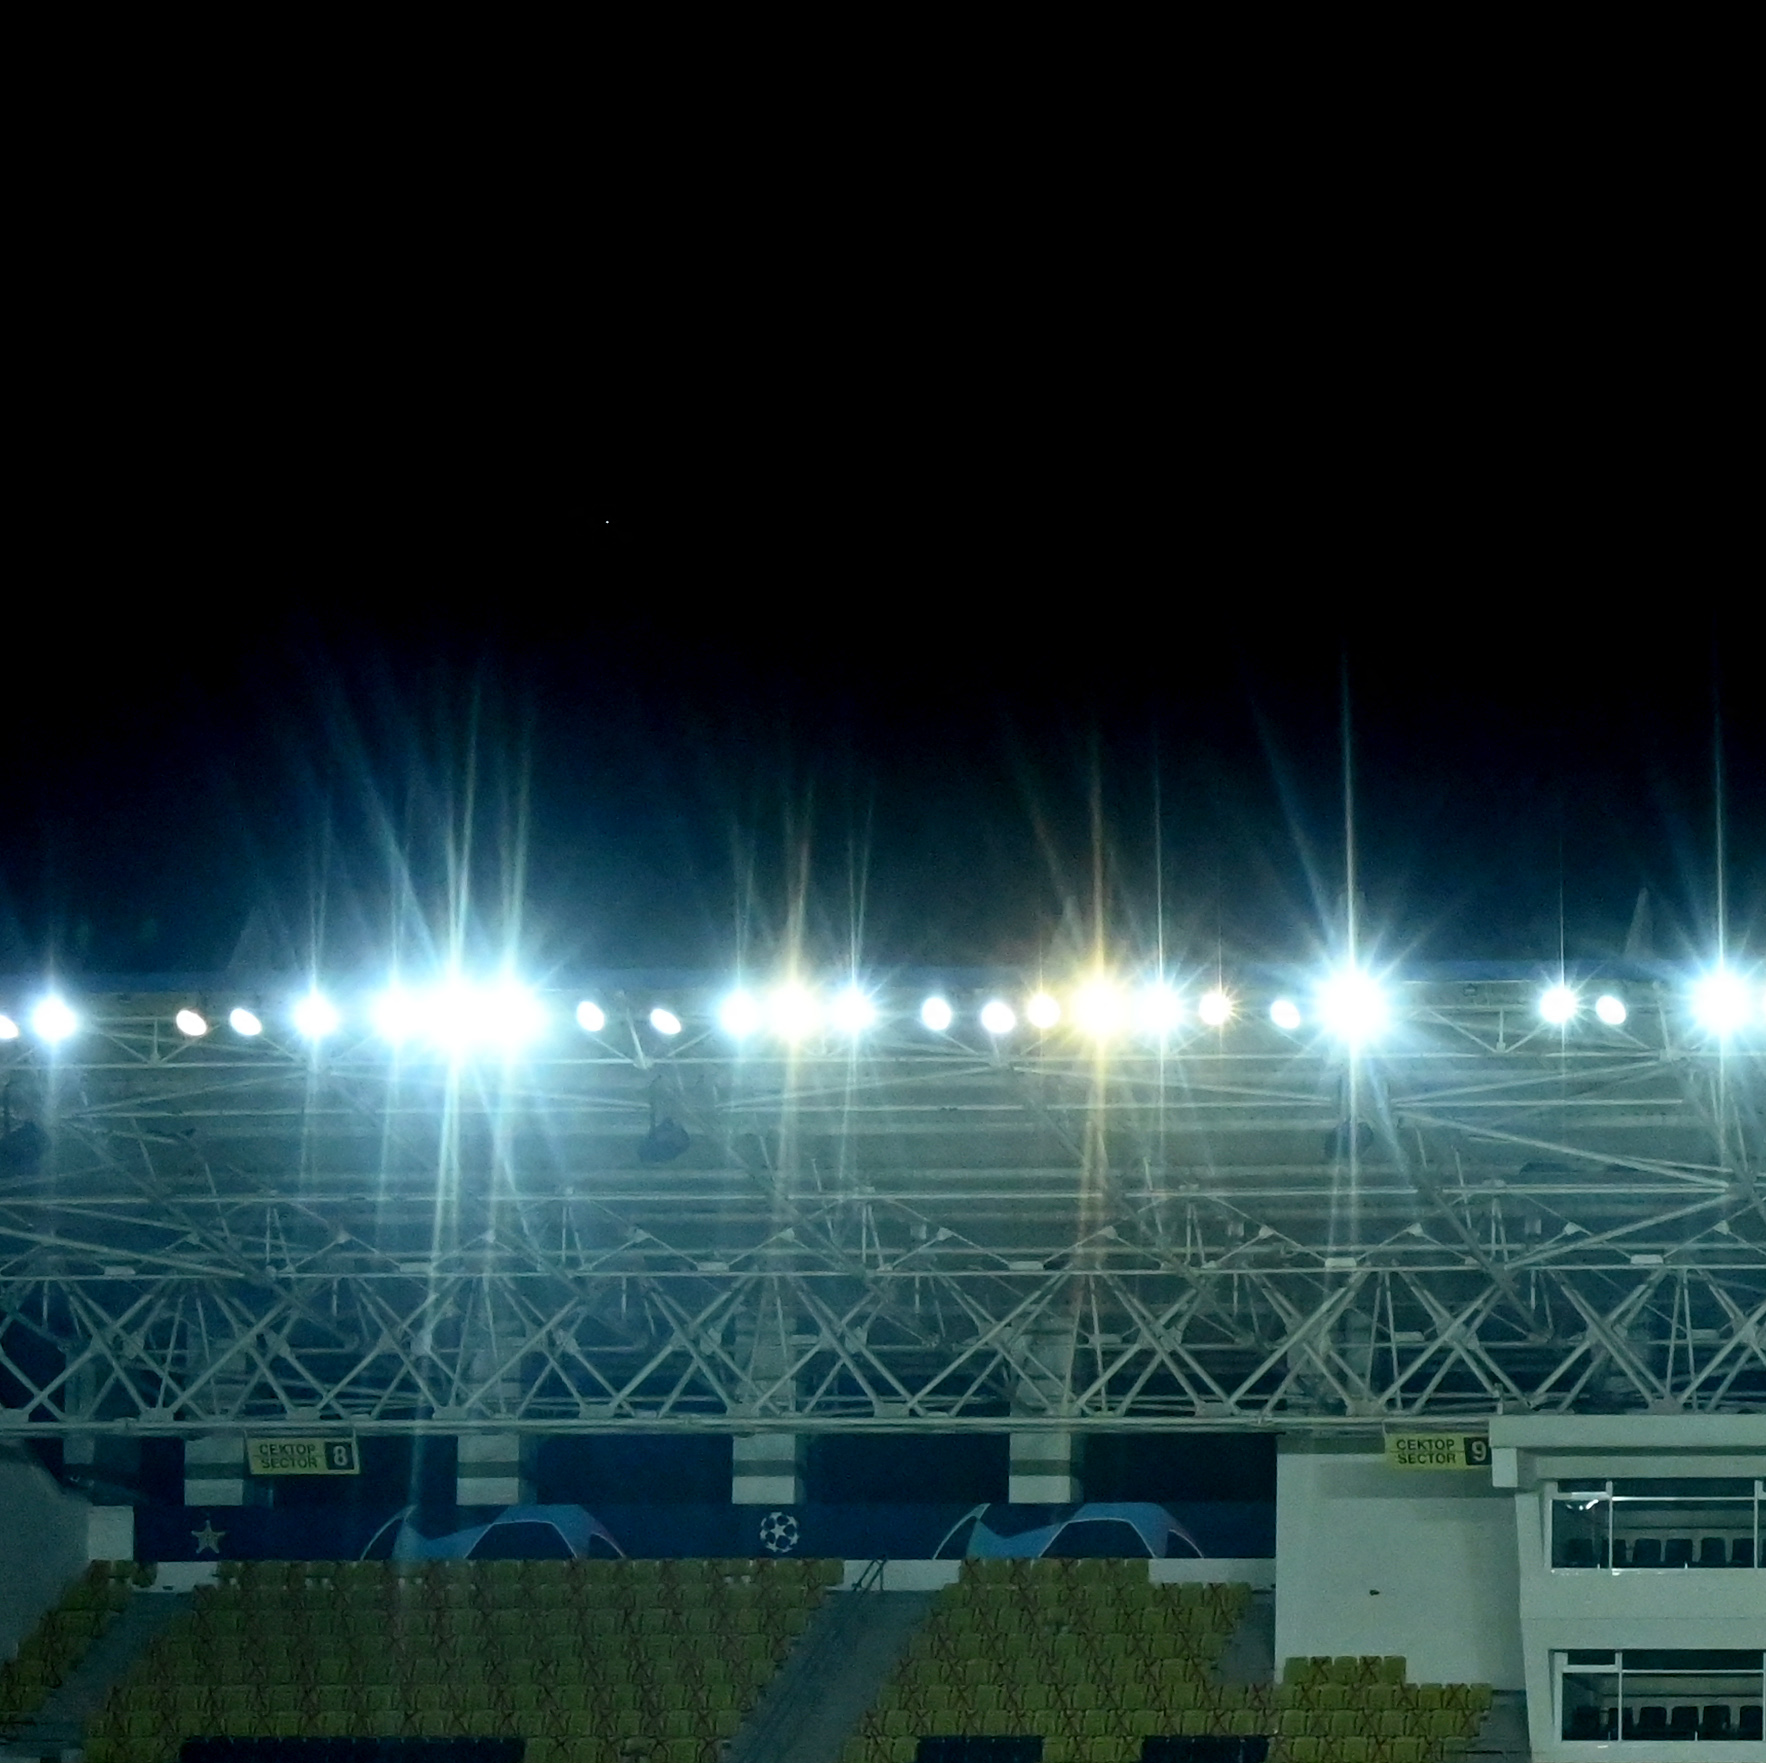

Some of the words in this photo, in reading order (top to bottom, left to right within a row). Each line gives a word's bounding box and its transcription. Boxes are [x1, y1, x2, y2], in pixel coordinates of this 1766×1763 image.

[333, 1445, 347, 1466] 8
[1398, 1453, 1456, 1464] SECTOR
[1471, 1441, 1486, 1461] 9
